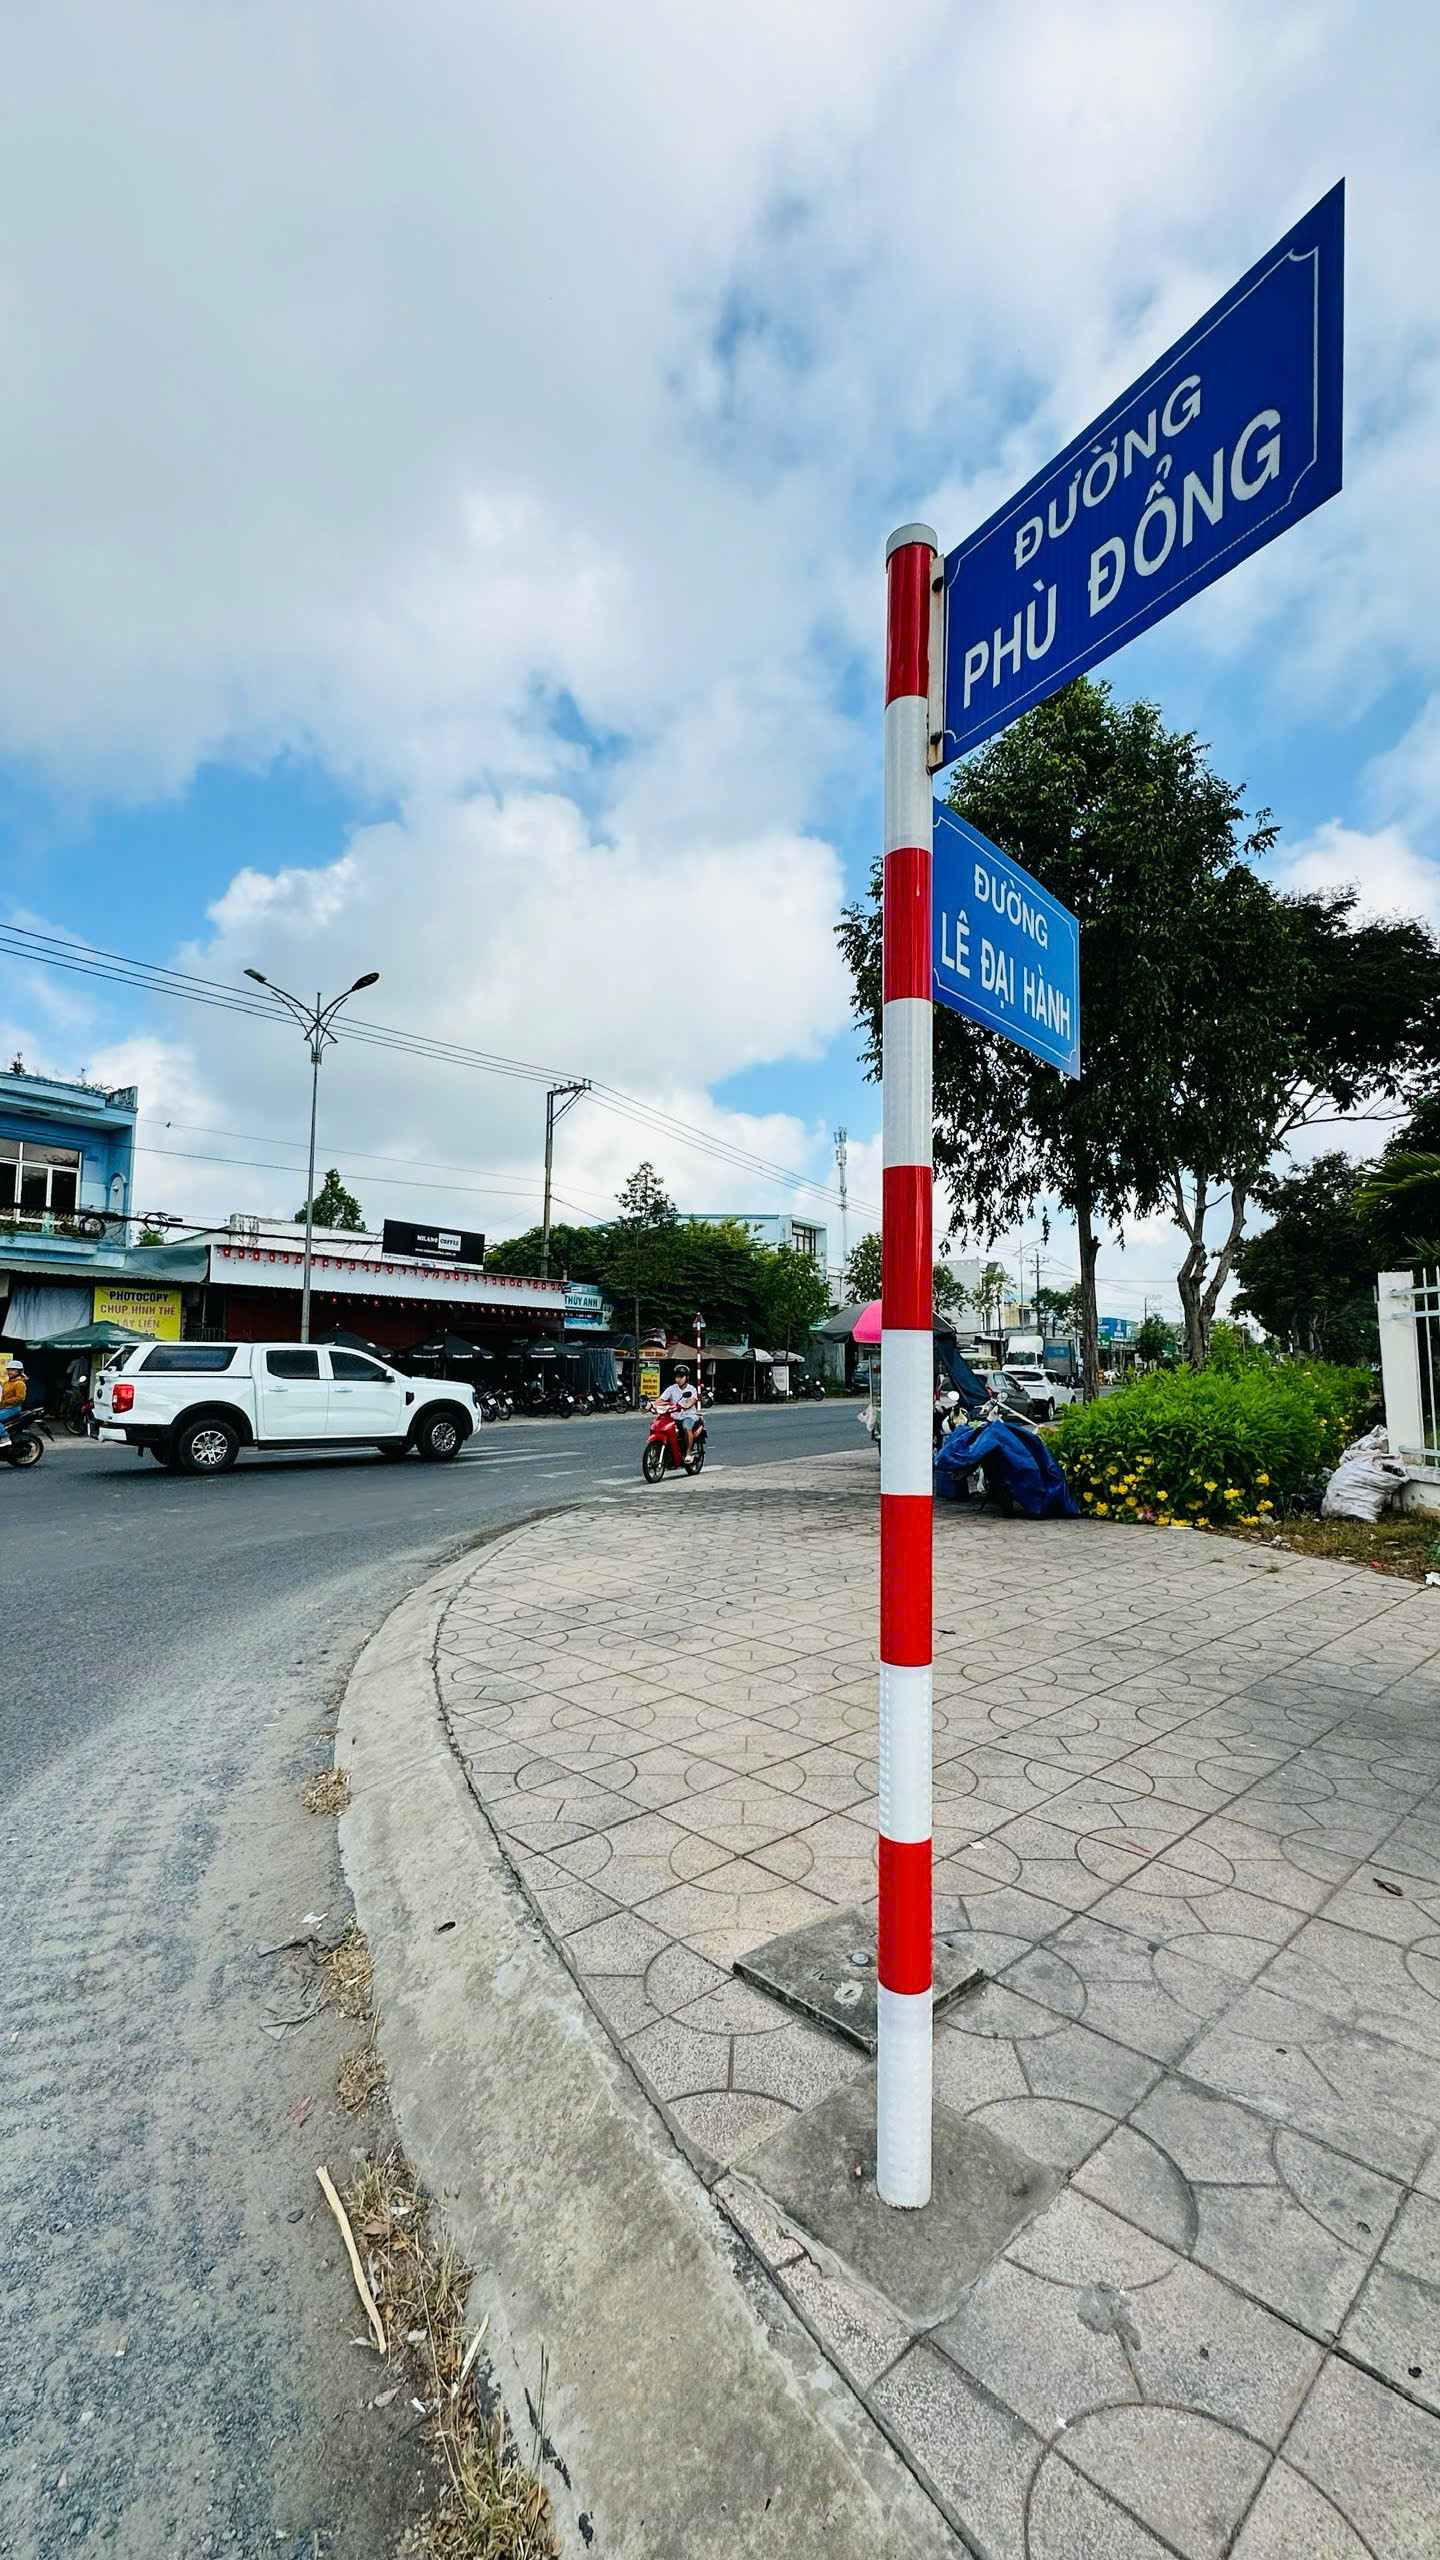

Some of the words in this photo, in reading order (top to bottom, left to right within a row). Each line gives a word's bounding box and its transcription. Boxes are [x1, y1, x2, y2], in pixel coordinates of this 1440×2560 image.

[1013, 373, 1202, 571] ĐƯỜNG
[963, 581, 1057, 708] PHÙ
[1088, 408, 1282, 618] ĐỔNG
[974, 863, 1048, 950] ĐƯỜNG
[941, 909, 971, 979] LÊ
[980, 937, 1015, 1009] ĐẠI
[1023, 964, 1071, 1040] HÀNH
[109, 1290, 168, 1303] PHOTOCOPY
[583, 1296, 598, 1308] ANH
